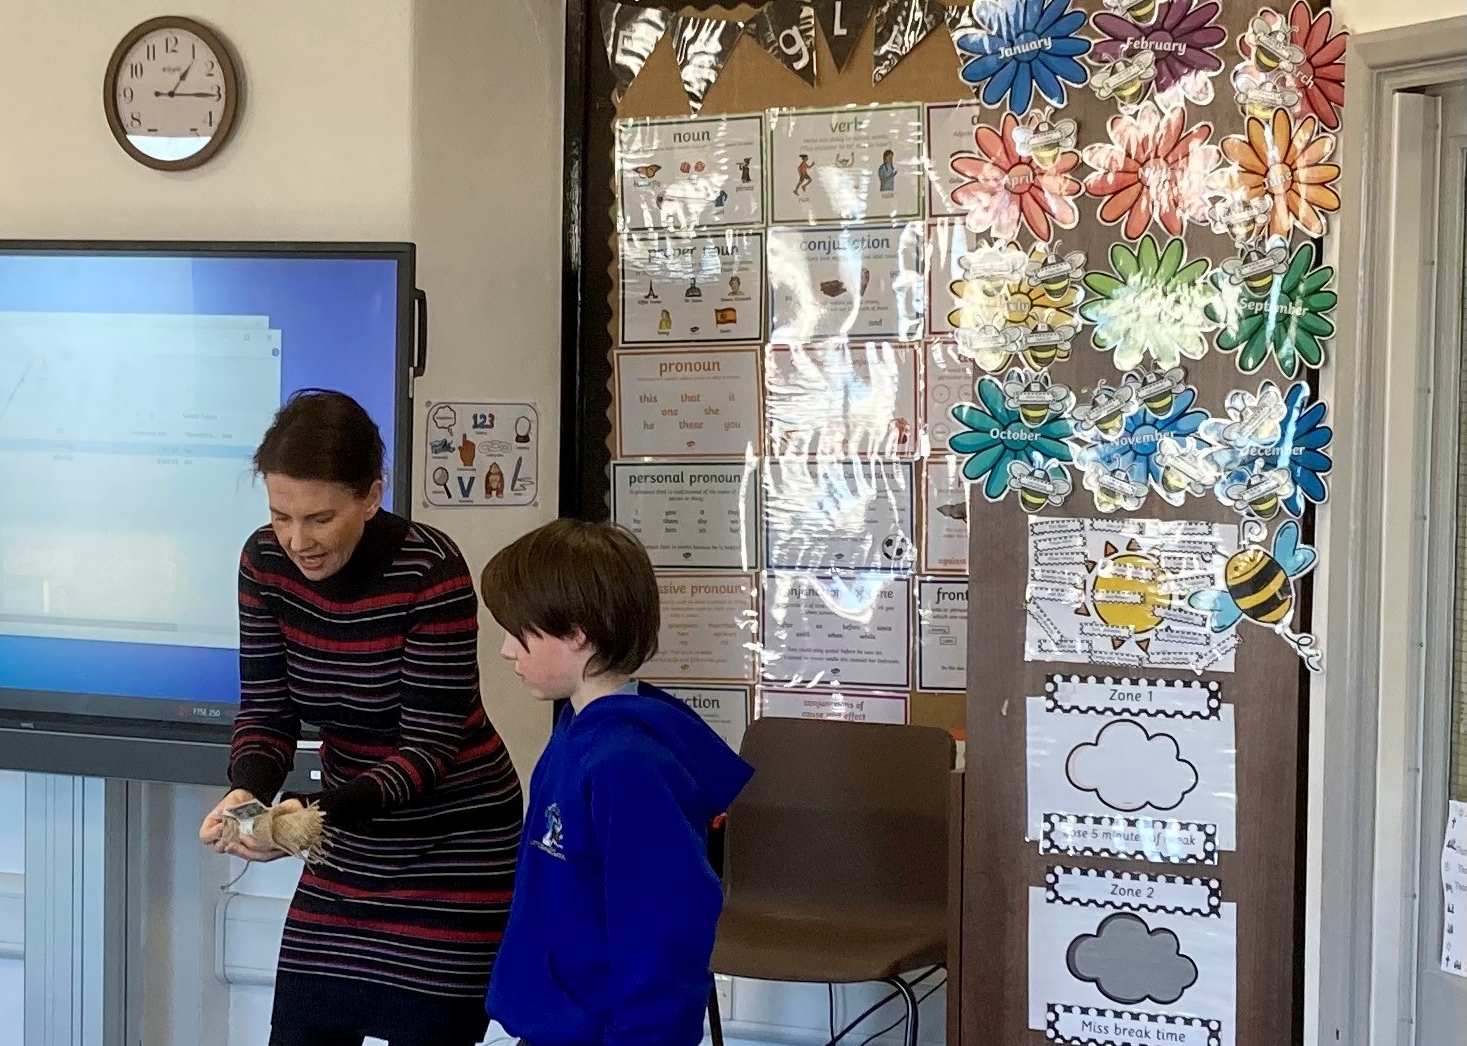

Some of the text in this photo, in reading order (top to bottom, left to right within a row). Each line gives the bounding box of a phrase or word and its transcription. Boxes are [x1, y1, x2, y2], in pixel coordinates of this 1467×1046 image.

[146, 43, 156, 61] 11
[165, 36, 179, 54] 12
[191, 42, 196, 60] 1
[997, 36, 1052, 59] January
[1124, 36, 1187, 56] February
[130, 62, 144, 79] 10
[205, 60, 215, 77] 2
[1295, 71, 1315, 89] rch
[123, 86, 134, 104] 9
[130, 112, 142, 128] 8
[673, 130, 711, 143] noun
[1002, 170, 1034, 188] April
[1239, 297, 1309, 317] Septmber
[659, 361, 721, 377] pronoun
[639, 393, 658, 403] this
[680, 393, 701, 402] that
[704, 405, 720, 415] she
[643, 420, 741, 431] he these you
[989, 427, 1041, 441] October
[1110, 428, 1176, 447] November
[629, 471, 741, 487] personal pronoun
[659, 583, 743, 597] ssive pronoun
[685, 694, 721, 709] ction
[1109, 688, 1154, 703] Zone 1
[844, 712, 866, 721] effect
[1068, 828, 1088, 838] ose
[1090, 828, 1098, 839] 5
[1110, 883, 1155, 899] Zone 2
[1081, 1019, 1187, 1044] Miss break time
